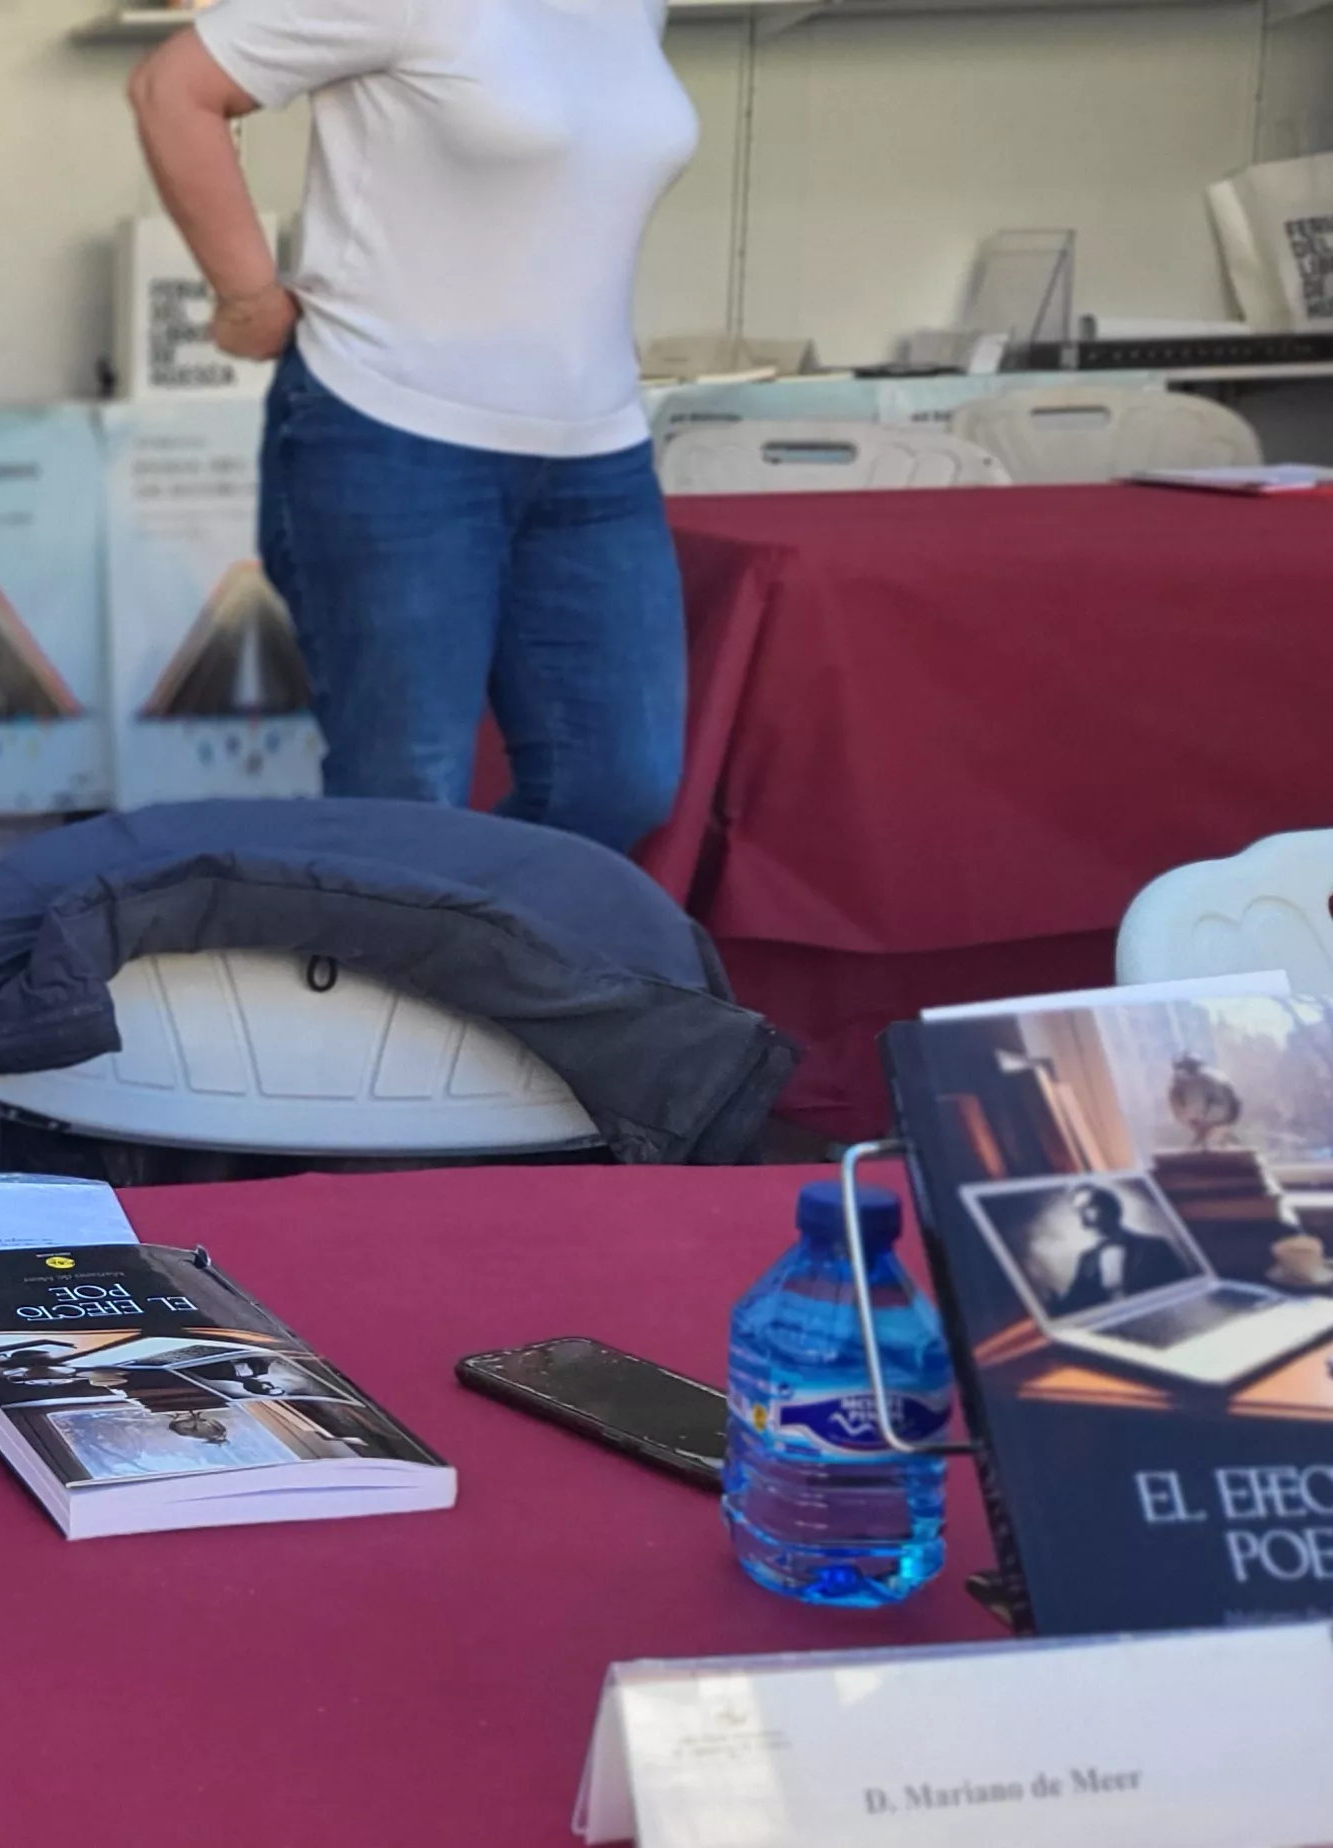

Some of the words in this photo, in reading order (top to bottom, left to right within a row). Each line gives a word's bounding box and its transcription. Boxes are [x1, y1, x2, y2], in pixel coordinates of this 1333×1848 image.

[16, 1299, 145, 1321] EFECTO
[48, 1283, 132, 1302] POE
[147, 1296, 199, 1312] EL
[1135, 1470, 1208, 1523] EL
[1225, 1528, 1333, 1583] POE
[864, 1787, 898, 1814] D.
[904, 1780, 1025, 1811] Mariano
[1030, 1772, 1062, 1799] de
[1070, 1766, 1143, 1795] Meer
